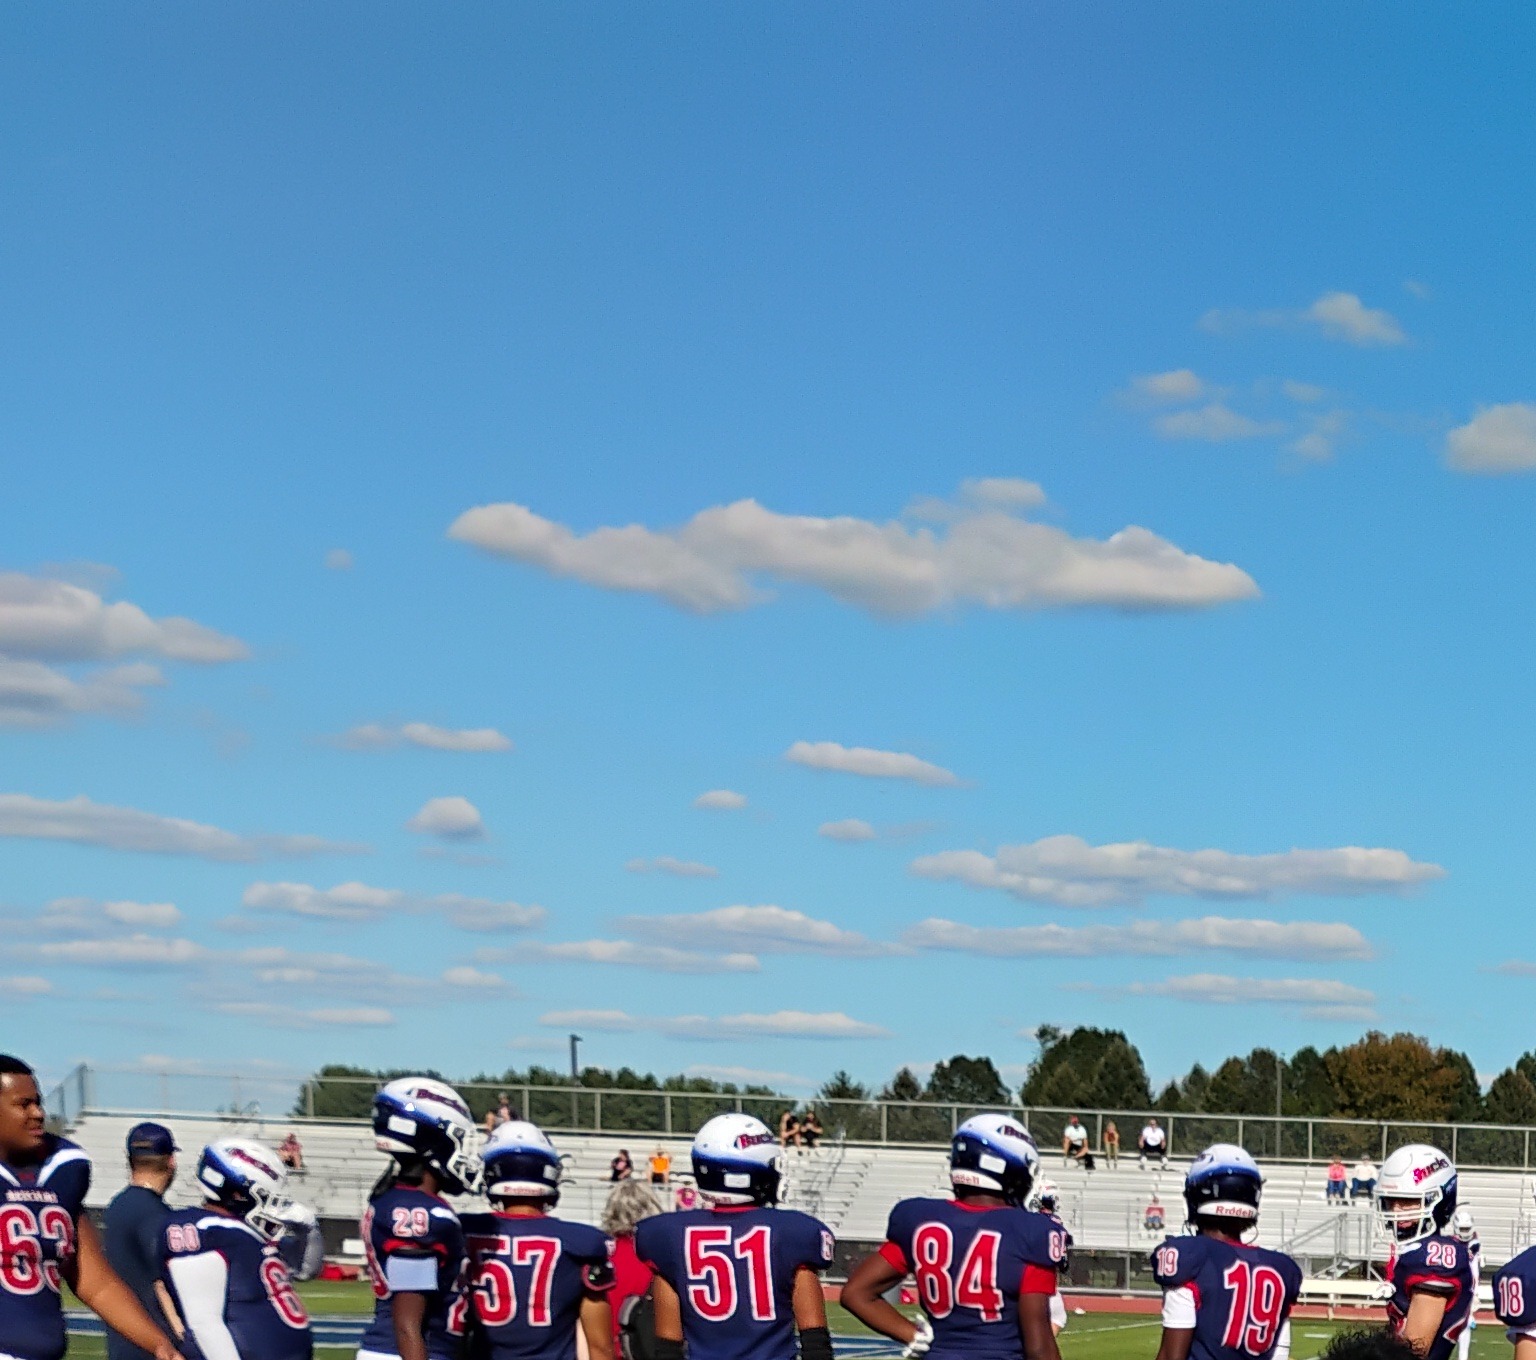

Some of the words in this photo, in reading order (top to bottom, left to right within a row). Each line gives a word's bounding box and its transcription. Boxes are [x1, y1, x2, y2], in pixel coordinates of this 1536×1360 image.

[0, 1204, 76, 1294] 63
[392, 1207, 429, 1237] 29
[1156, 1247, 1179, 1276] 19
[1426, 1242, 1457, 1269] 28
[469, 1235, 561, 1327] 57
[685, 1226, 776, 1321] 51
[912, 1222, 1004, 1322] 84
[1222, 1260, 1286, 1356] 19
[1500, 1277, 1524, 1317] 18
